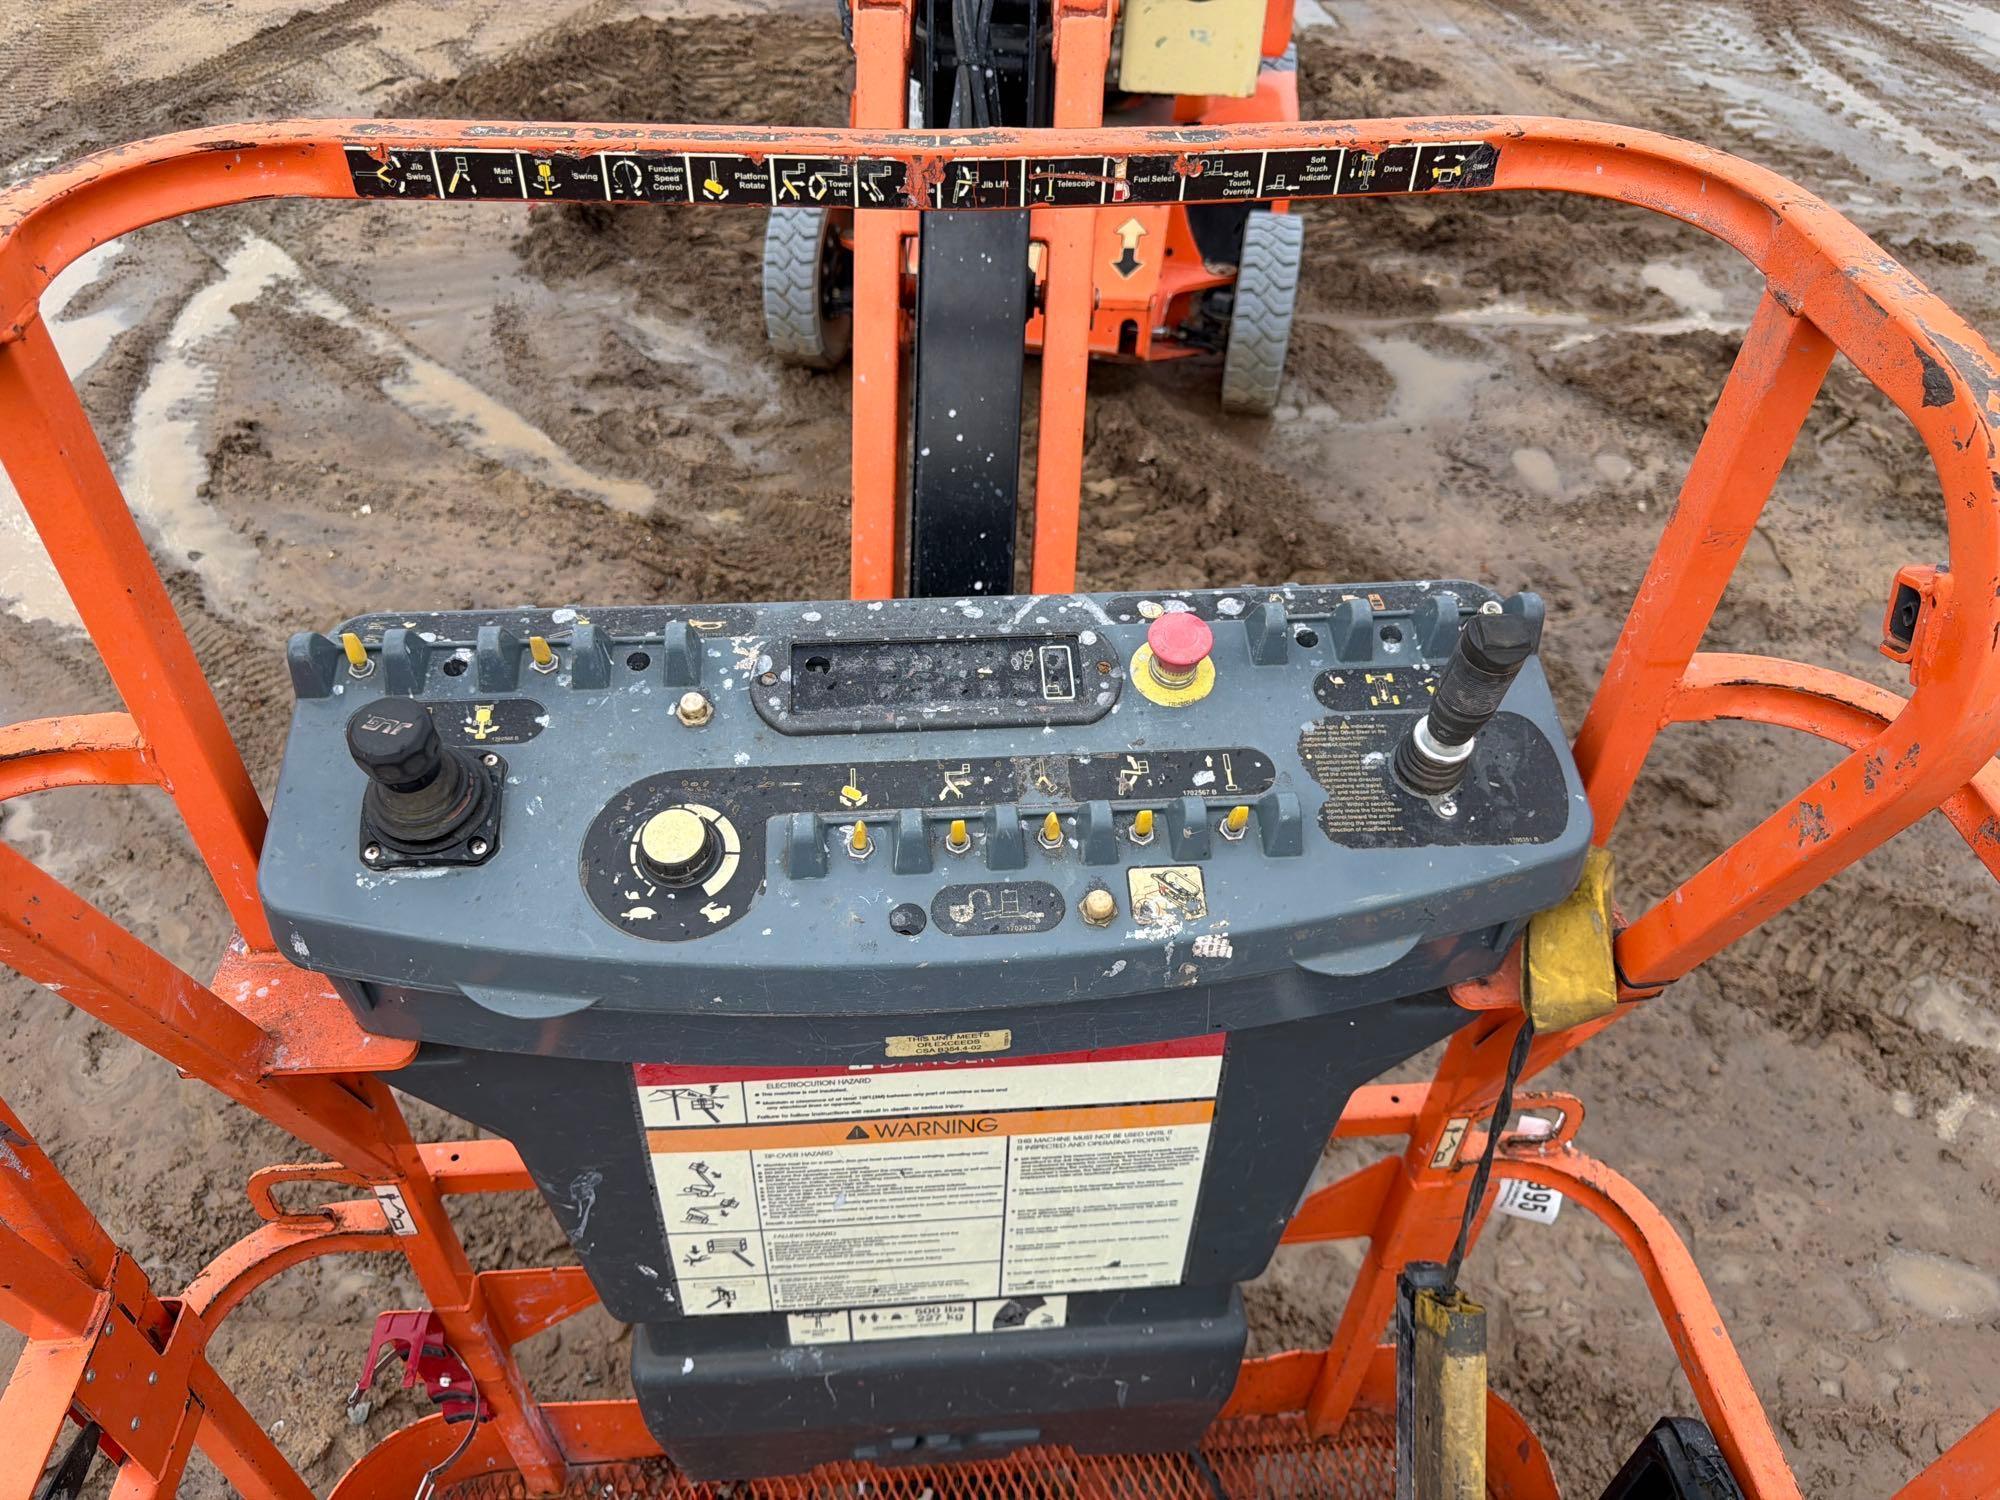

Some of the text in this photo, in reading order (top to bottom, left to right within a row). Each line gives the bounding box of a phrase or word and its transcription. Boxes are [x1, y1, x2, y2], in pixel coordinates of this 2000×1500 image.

[1311, 156, 1326, 164] Soft
[410, 163, 423, 171] Jib
[648, 165, 684, 174] Function
[1306, 164, 1328, 173] Touch
[1384, 165, 1403, 173] Drive
[1472, 162, 1489, 171] Steer
[493, 167, 513, 176] Main
[1234, 170, 1249, 178] Soft
[406, 172, 432, 182] Swing
[498, 176, 513, 185] Lift
[573, 171, 598, 182] Swing
[654, 174, 680, 183] Speed
[734, 172, 768, 181] Platform
[1134, 174, 1175, 183] Fuel Select
[1299, 173, 1331, 181] Indicator
[653, 183, 683, 192] Control
[739, 180, 766, 189] Rotate
[828, 180, 852, 189] Tower
[981, 180, 1009, 189] Jib Lift
[1057, 180, 1096, 189] Telescope
[1229, 179, 1251, 187] Touch
[833, 188, 847, 197] Lift
[1222, 187, 1254, 196] Override
[361, 714, 414, 736] JLG
[906, 1032, 990, 1043] THIS UNIT MEETS
[934, 1039, 980, 1048] EXCEEDS
[766, 1077, 871, 1090] ELECTROCUTION HAZARD
[874, 1117, 999, 1139] WARNING
[1033, 1136, 1072, 1144] MACHINE
[1072, 1134, 1093, 1142] MUST
[1094, 1133, 1112, 1141] NOT
[1124, 1131, 1145, 1139] USED
[1025, 1142, 1067, 1151] INSPECTED
[1087, 1138, 1131, 1147] OPERATING
[800, 1150, 834, 1159] HAZARD
[914, 1304, 966, 1315] 500 lbs
[916, 1312, 964, 1323] 227 kg
